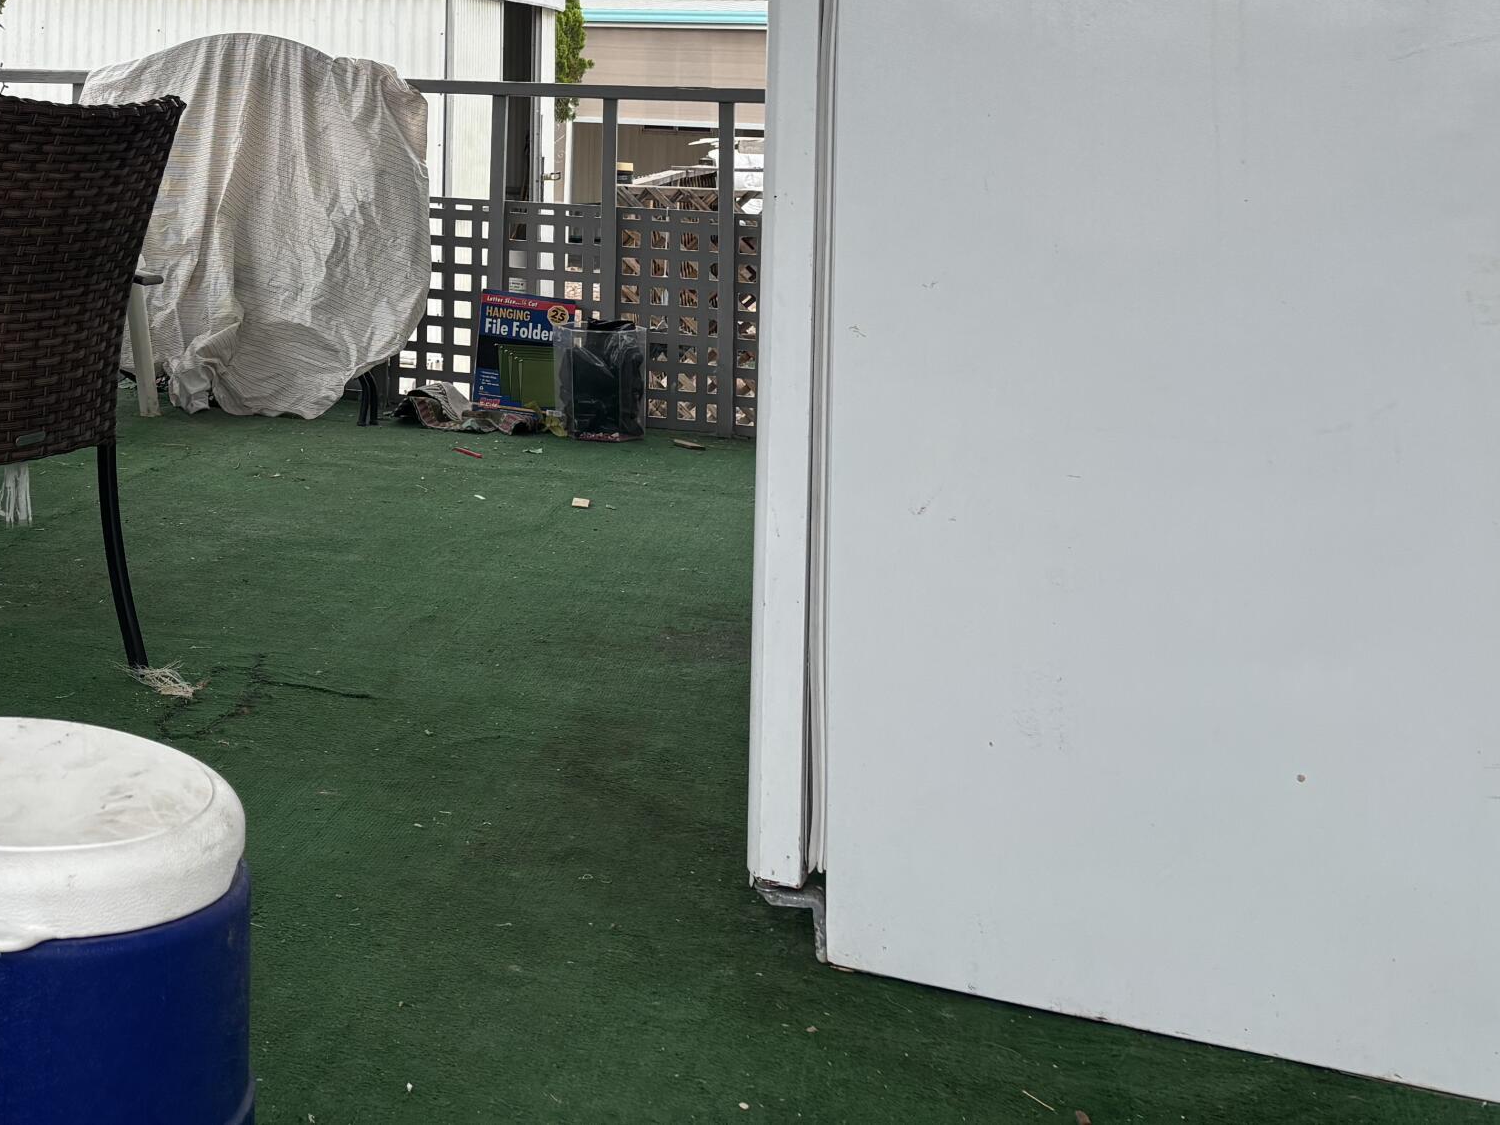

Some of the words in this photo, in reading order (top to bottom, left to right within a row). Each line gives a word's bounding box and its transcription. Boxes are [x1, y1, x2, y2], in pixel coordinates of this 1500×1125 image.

[486, 305, 530, 321] HANGING
[550, 309, 566, 322] 25
[484, 318, 508, 335] File
